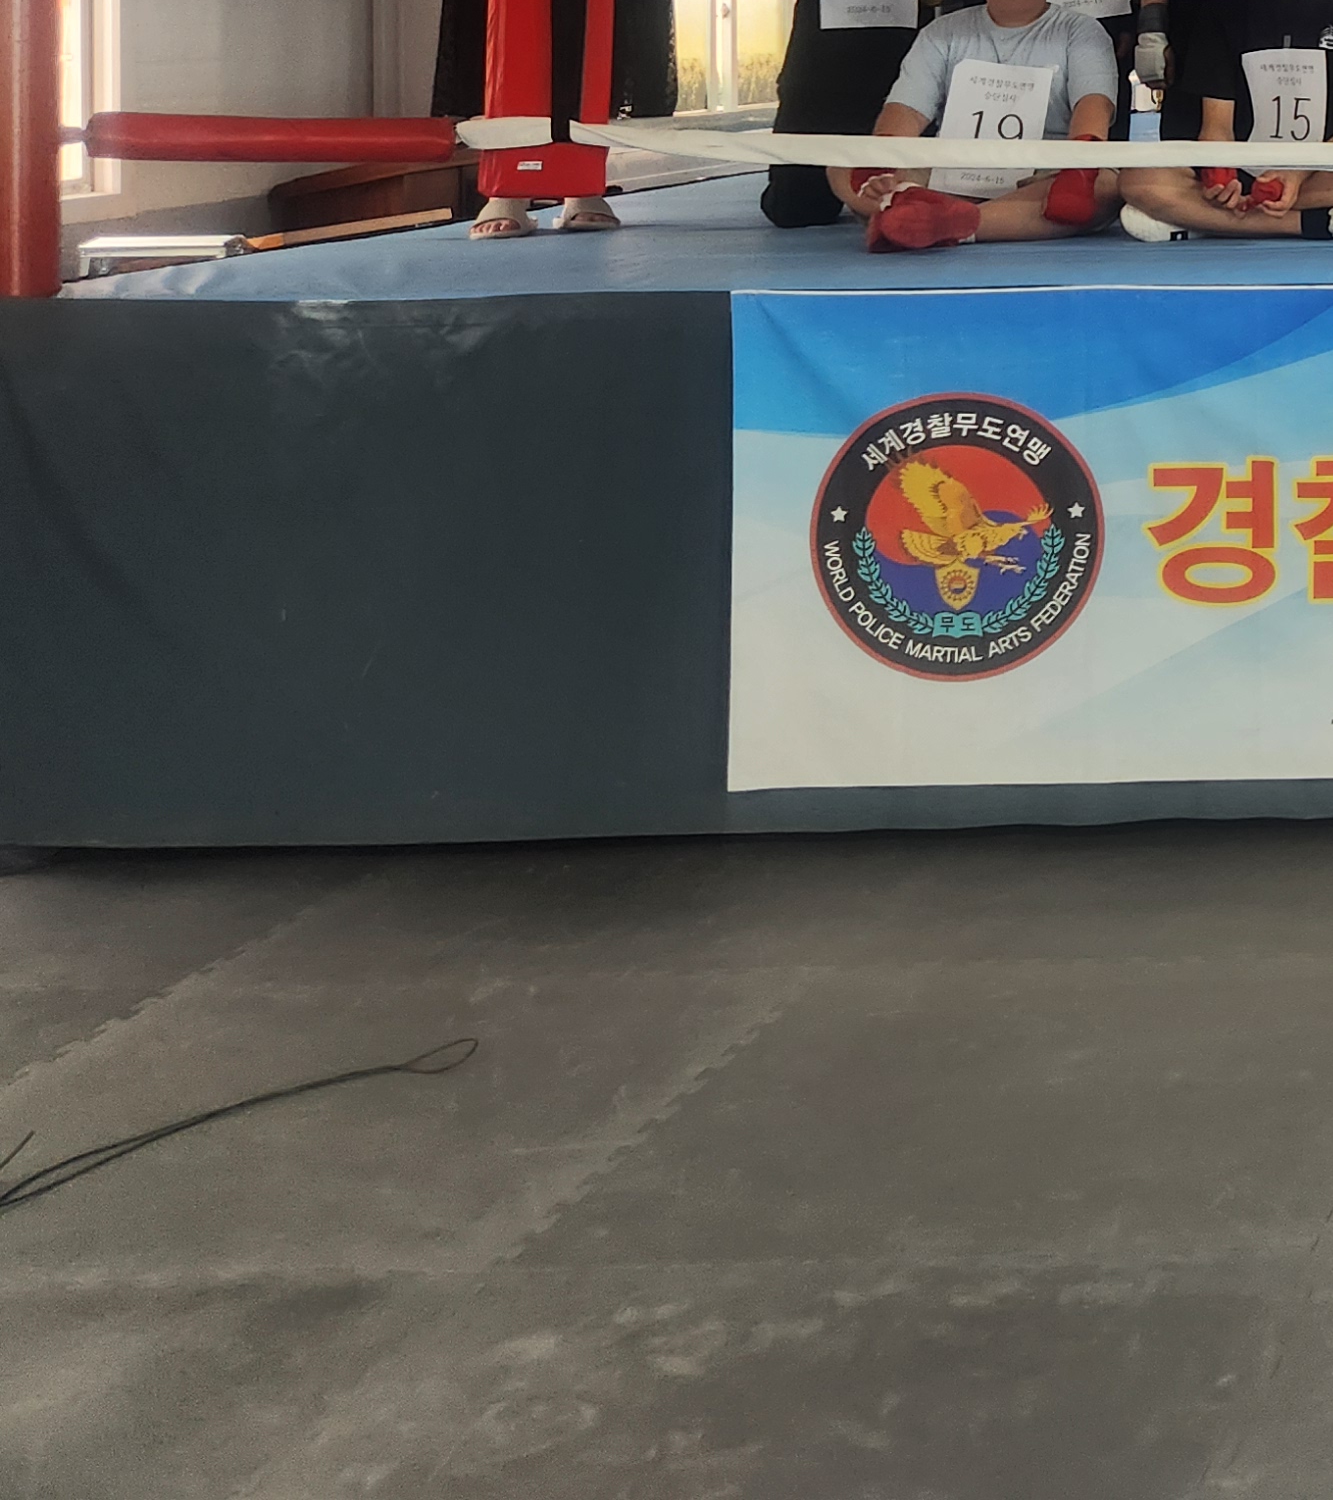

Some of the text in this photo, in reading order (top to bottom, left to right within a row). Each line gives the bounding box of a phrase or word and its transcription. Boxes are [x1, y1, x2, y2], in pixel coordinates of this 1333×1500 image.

[1270, 96, 1311, 141] 15
[861, 413, 1052, 472] 세계경찰무도연맹
[823, 533, 1092, 664] WORLD POLICE MARTIAL ARTS FEDERATION
